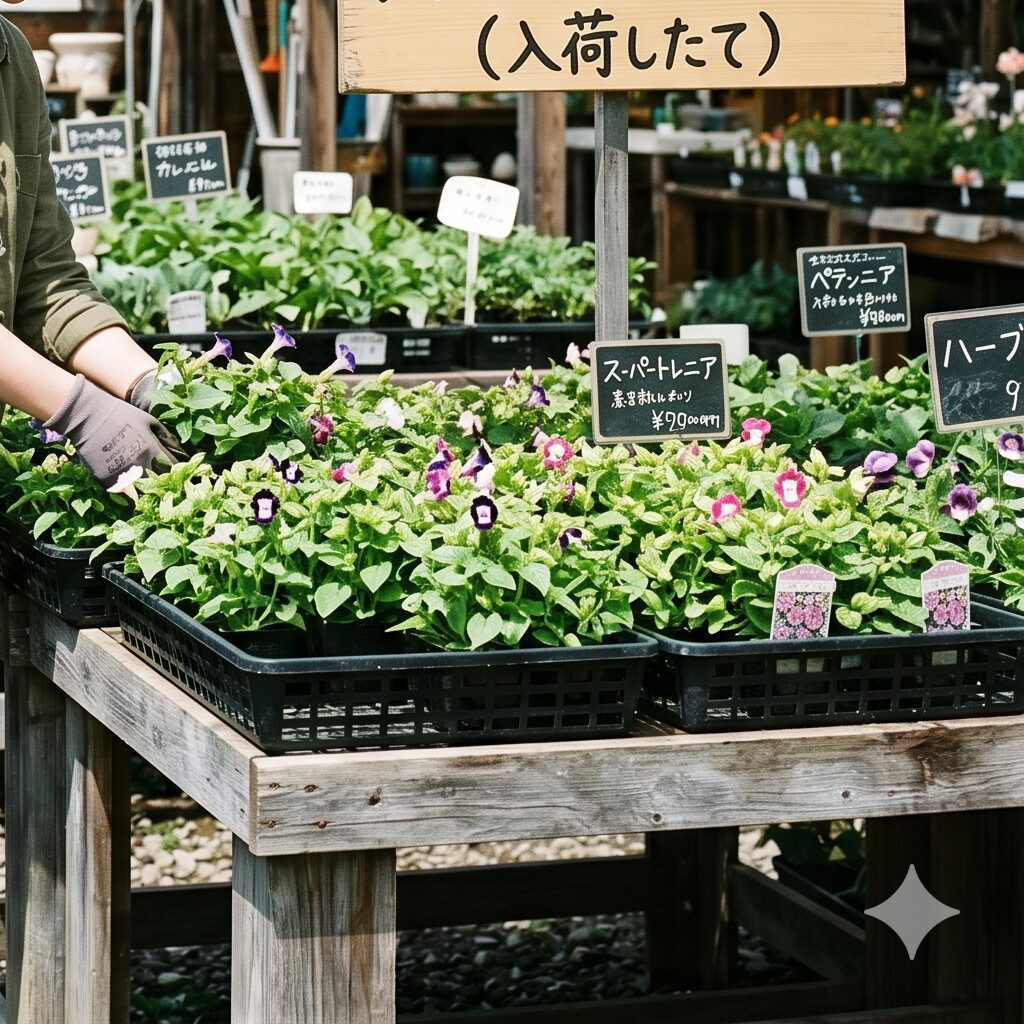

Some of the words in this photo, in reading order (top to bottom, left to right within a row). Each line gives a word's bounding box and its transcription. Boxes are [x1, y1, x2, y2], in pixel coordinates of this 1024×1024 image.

[477, 9, 780, 81] (入荷したて)
[943, 323, 1024, 368] ハーブ
[603, 355, 718, 383] スーパートレニア
